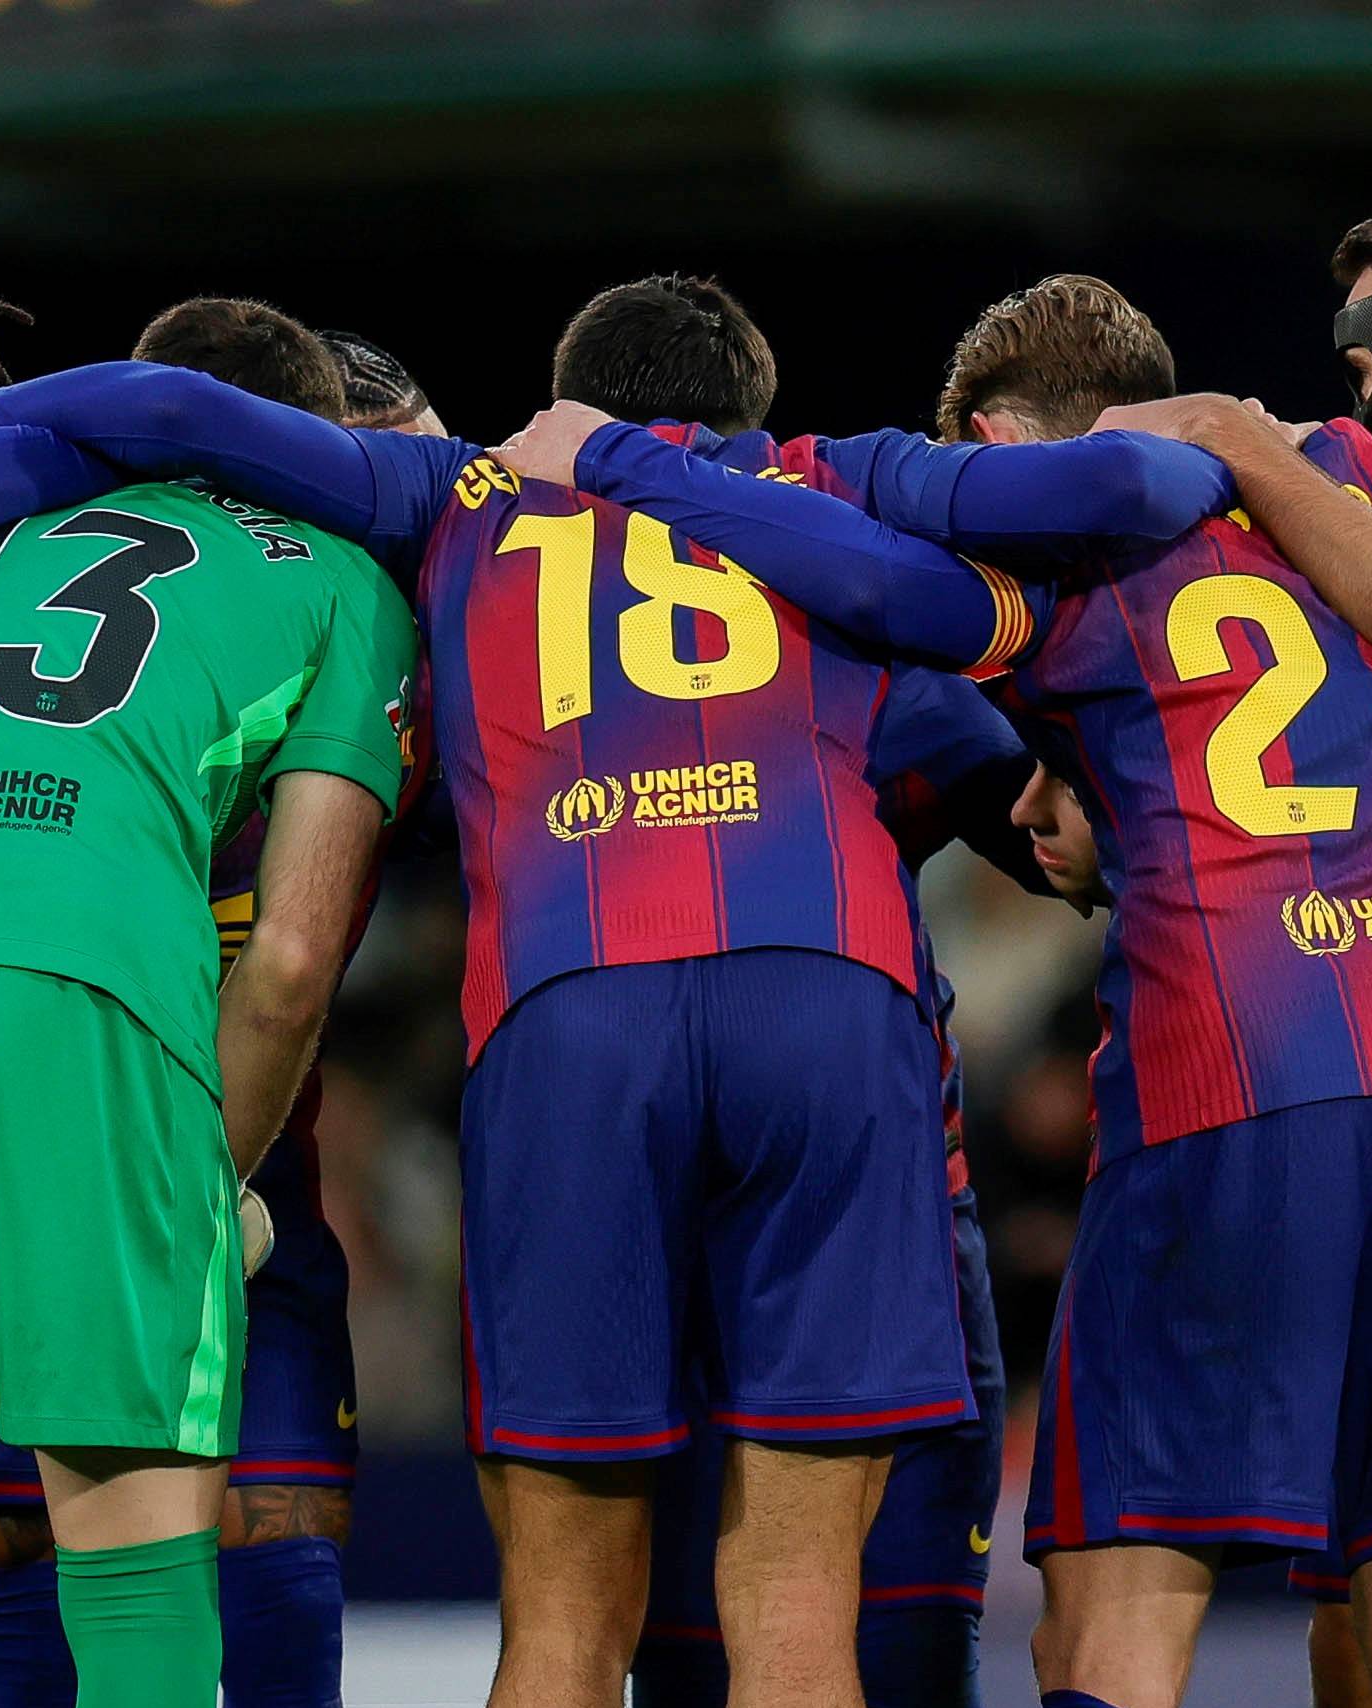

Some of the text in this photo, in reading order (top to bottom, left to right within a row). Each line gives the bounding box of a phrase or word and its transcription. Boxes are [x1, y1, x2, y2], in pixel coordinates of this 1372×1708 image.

[494, 507, 781, 732] 18
[630, 760, 757, 795] UNHCR
[632, 786, 760, 819] ACNUR
[34, 823, 72, 836] Agency
[635, 812, 759, 828] The UN Refugee Agency
